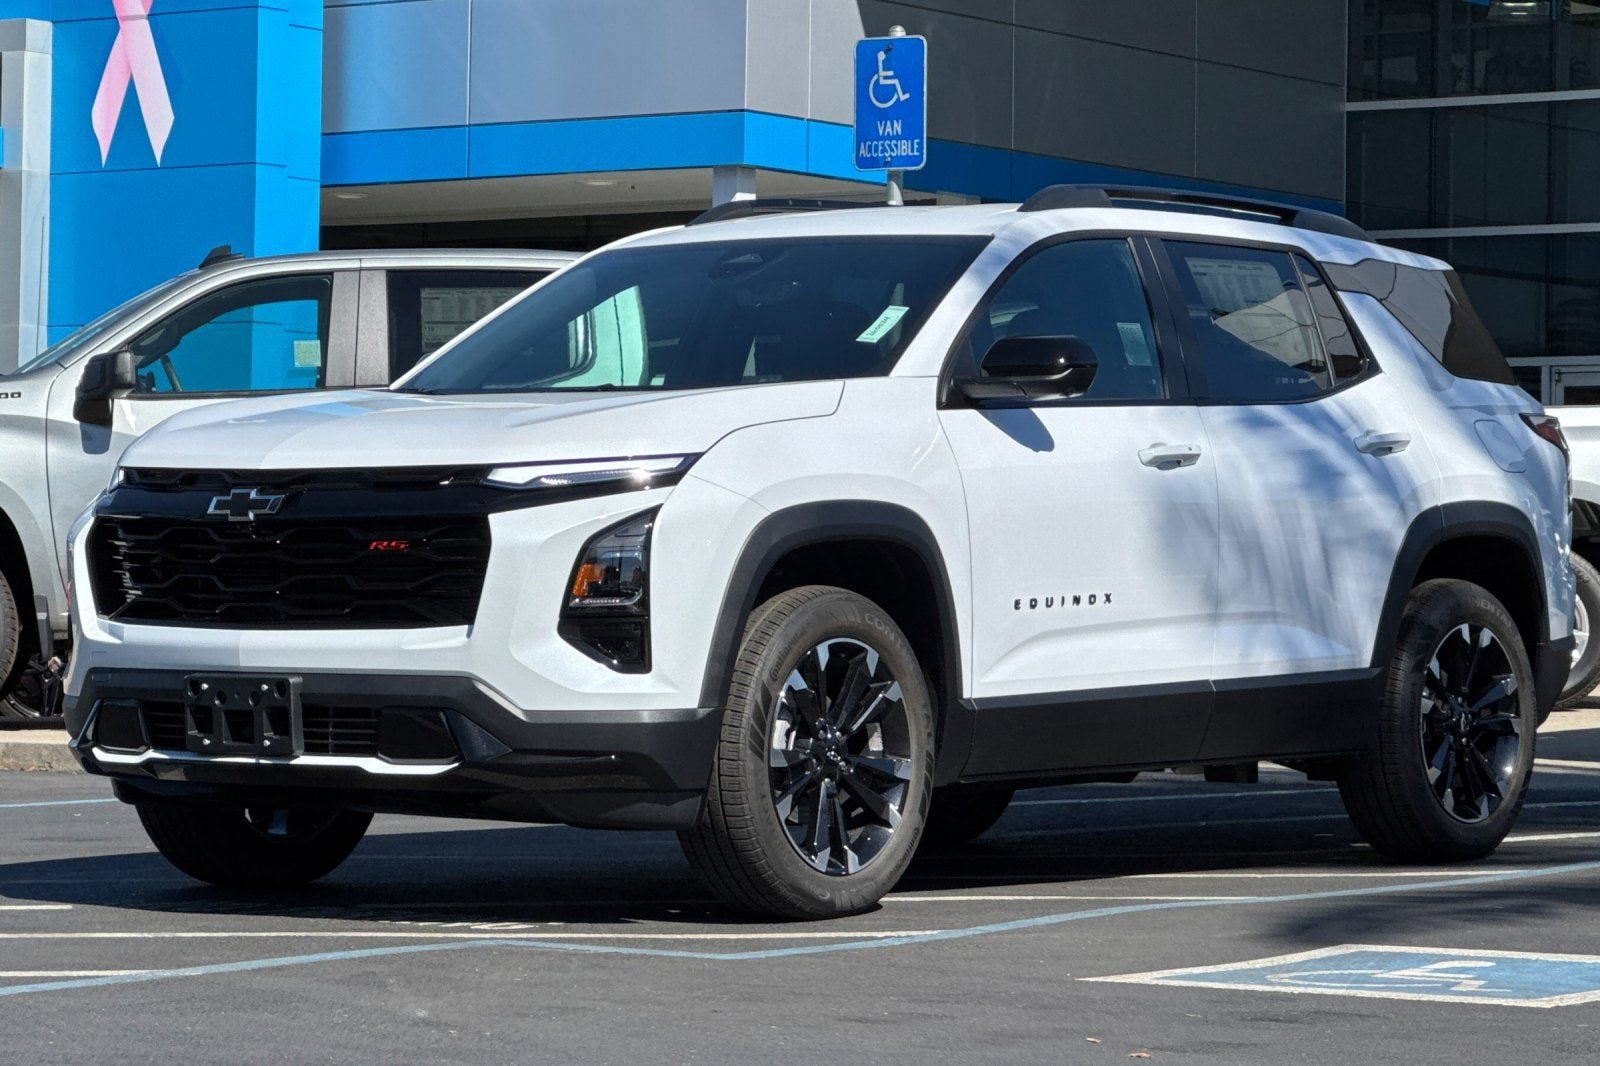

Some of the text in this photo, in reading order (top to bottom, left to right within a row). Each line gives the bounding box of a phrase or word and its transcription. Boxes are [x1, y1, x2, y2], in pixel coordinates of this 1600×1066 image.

[877, 119, 902, 136] VAN
[859, 139, 920, 157] ACCESSIBLE
[369, 541, 409, 551] RS
[1013, 592, 1112, 610] EQUINOX
